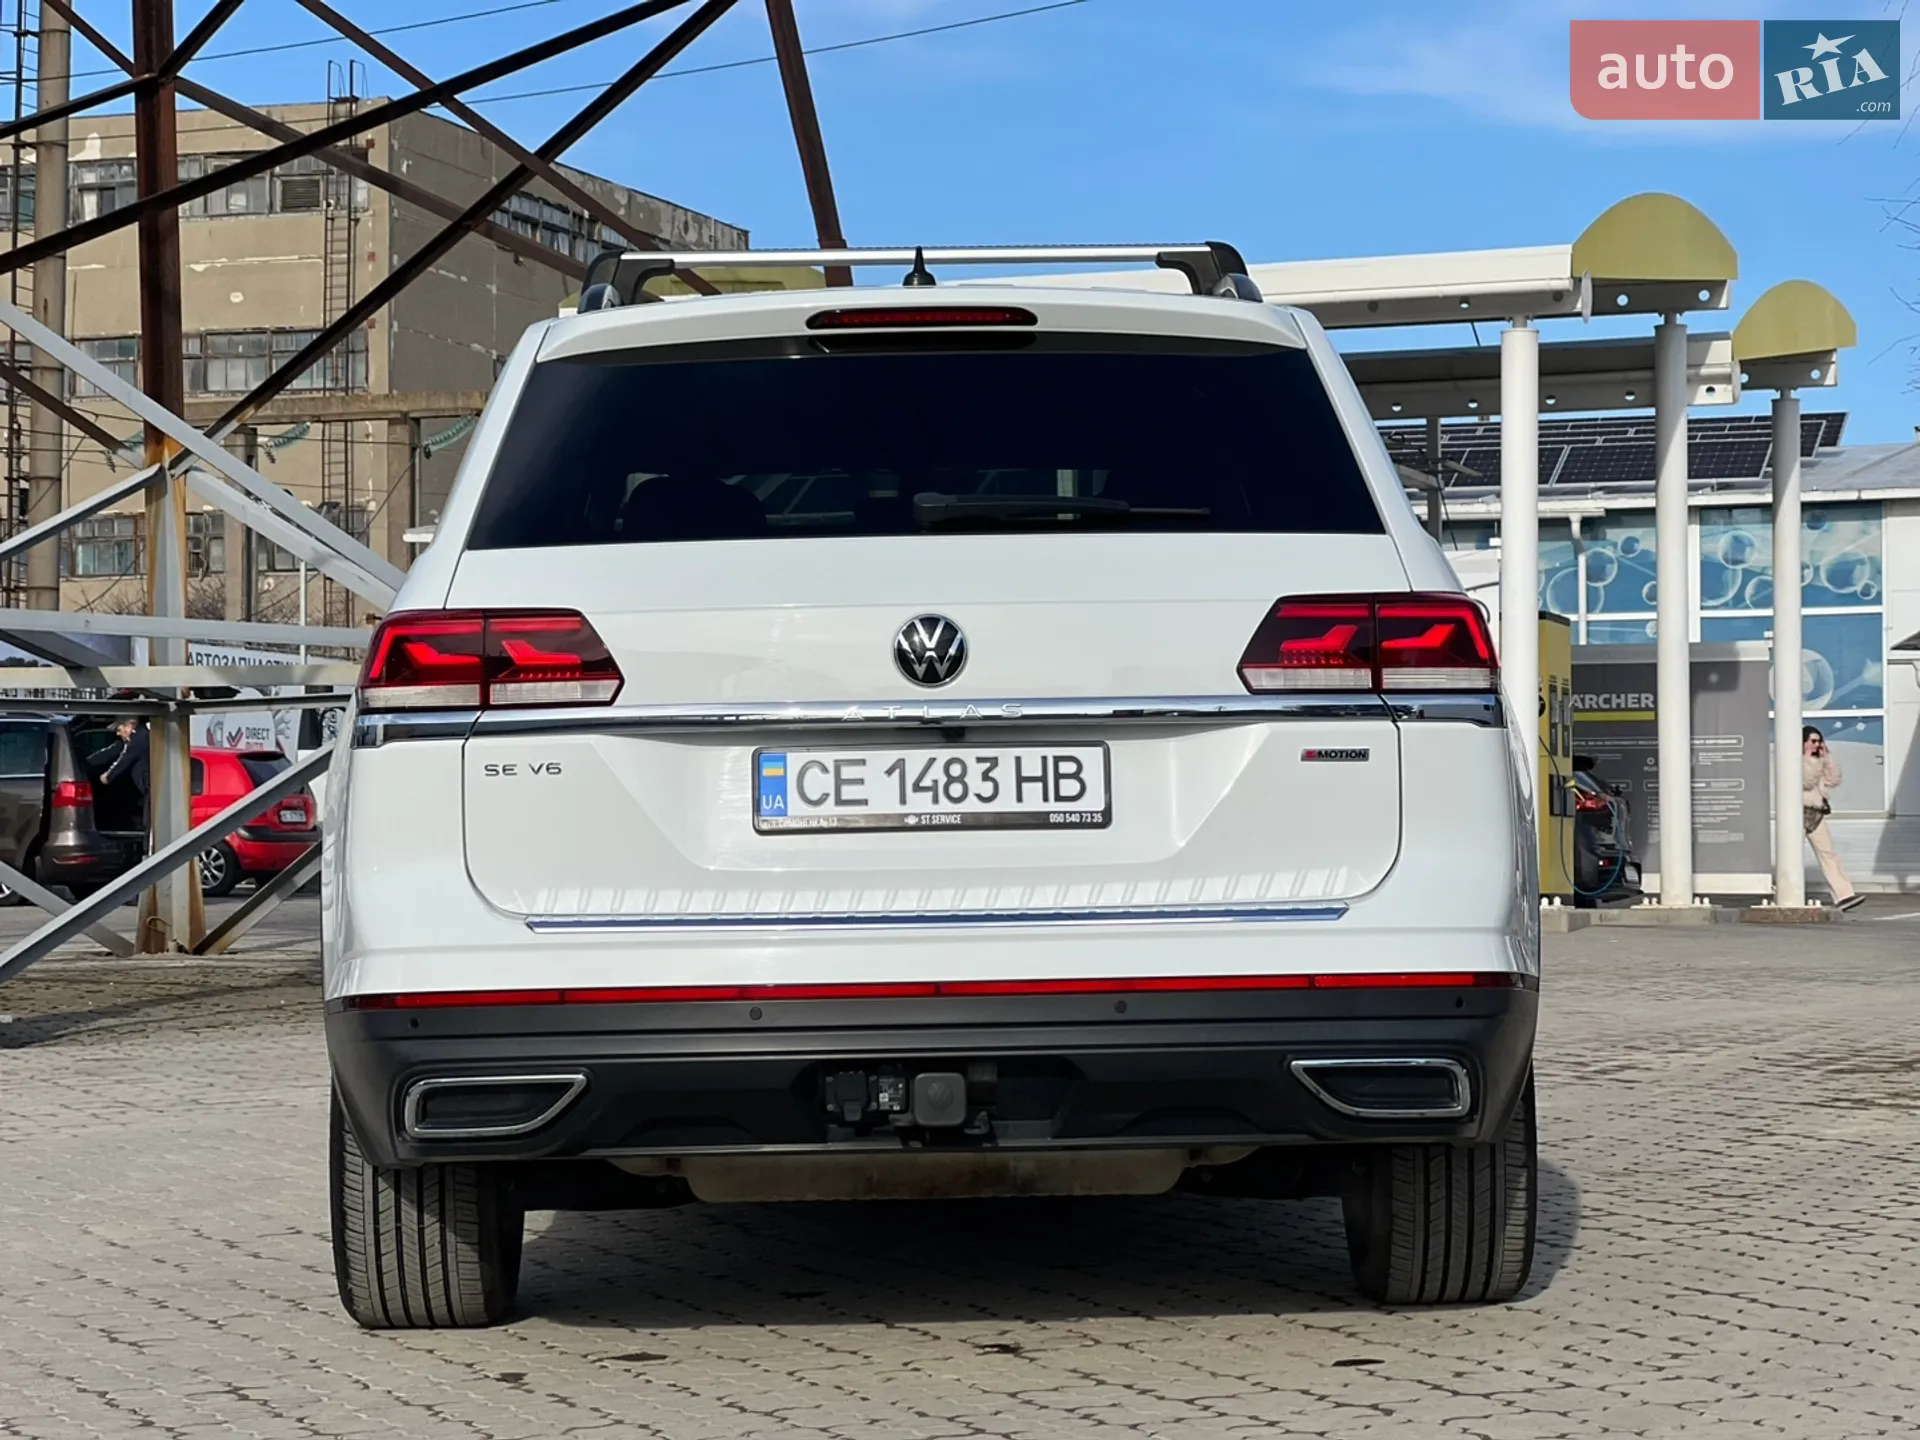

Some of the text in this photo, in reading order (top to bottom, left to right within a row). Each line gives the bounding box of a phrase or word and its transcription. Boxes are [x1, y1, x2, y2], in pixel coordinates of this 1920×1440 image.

[1569, 693, 1655, 709] ÄRCHER
[841, 702, 1023, 722] ATLAS
[245, 727, 270, 741] DIRECT
[484, 762, 562, 777] SE V6
[796, 755, 1087, 807] CE 1483 HB
[762, 795, 785, 810] UA
[921, 814, 962, 824] ST SERVICE
[1049, 813, 1065, 823] 050
[1081, 813, 1091, 822] 73
[1092, 812, 1103, 822] 35
